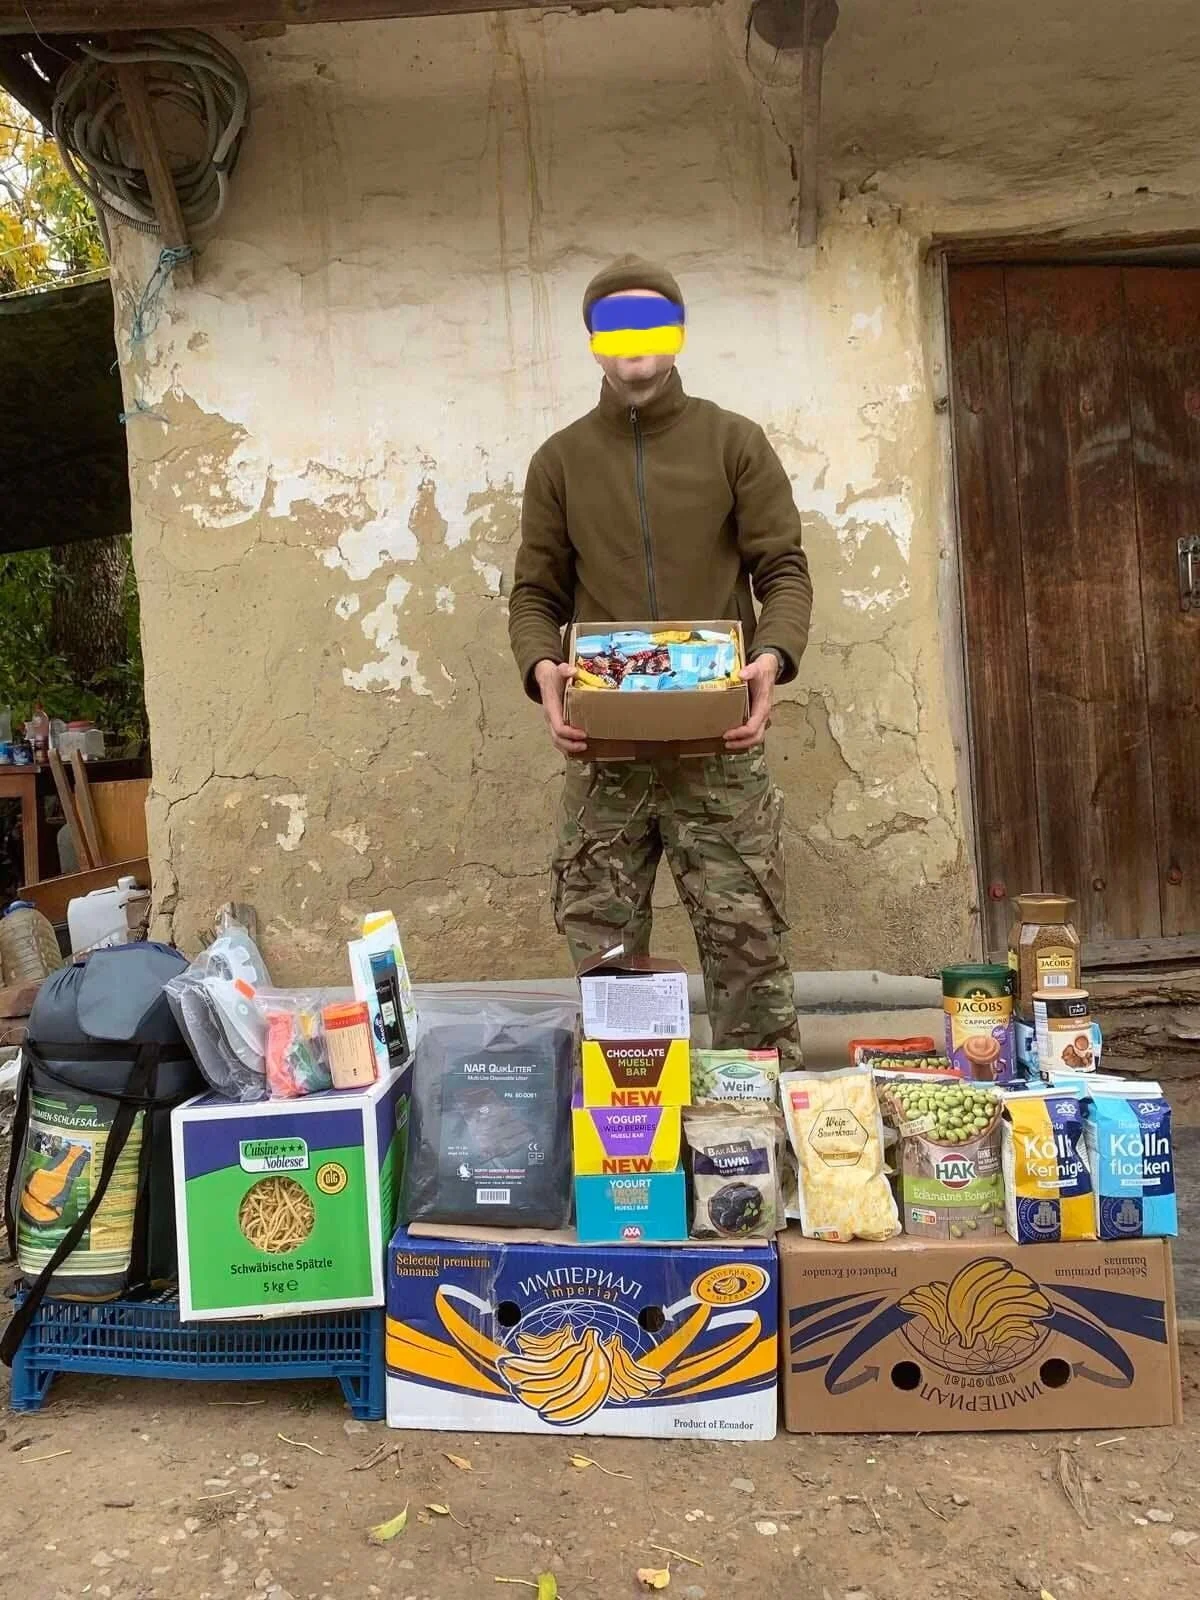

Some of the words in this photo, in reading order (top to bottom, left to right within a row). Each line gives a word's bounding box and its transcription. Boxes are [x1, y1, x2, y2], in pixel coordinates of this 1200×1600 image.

[956, 1001, 1003, 1013] JACOBS
[606, 1048, 665, 1058] CHOCOLATE
[464, 1063, 486, 1073] NAR
[618, 1059, 654, 1068] MUESLI
[626, 1068, 647, 1076] BAR
[722, 1081, 761, 1092] Wein-
[611, 1091, 662, 1106] NEW
[606, 1115, 648, 1124] YOGURT
[244, 1142, 279, 1157] Cuisine
[1110, 1133, 1169, 1157] Kölln
[264, 1156, 305, 1169] Noblesse
[602, 1158, 653, 1174] NEW
[1110, 1159, 1170, 1175] flocken
[935, 1162, 976, 1180] HAK
[1026, 1160, 1083, 1178] Kernige
[609, 1179, 652, 1188] YOGURT
[623, 1227, 641, 1236] AXA
[230, 1262, 294, 1275] Schwäbische
[296, 1258, 333, 1272] Spätzle
[396, 1253, 440, 1266] Selected
[443, 1257, 490, 1270] premium
[1104, 1257, 1147, 1267] bananas
[396, 1266, 440, 1278] bananas
[802, 1267, 843, 1279] Ecuador
[846, 1268, 857, 1278] of
[859, 1267, 897, 1277] Product
[1055, 1266, 1101, 1278] premium
[1104, 1267, 1147, 1278] Selected
[263, 1282, 270, 1292] 5
[272, 1281, 284, 1293] kg
[518, 1267, 643, 1300] ИМПЕРИАЛ
[544, 1286, 619, 1302] imperial
[944, 1373, 1016, 1388] imperial
[919, 1381, 1044, 1412] ИМПЕРИАЛ
[674, 1418, 706, 1429] Product
[708, 1419, 717, 1429] of
[720, 1420, 754, 1430] Ecuador
